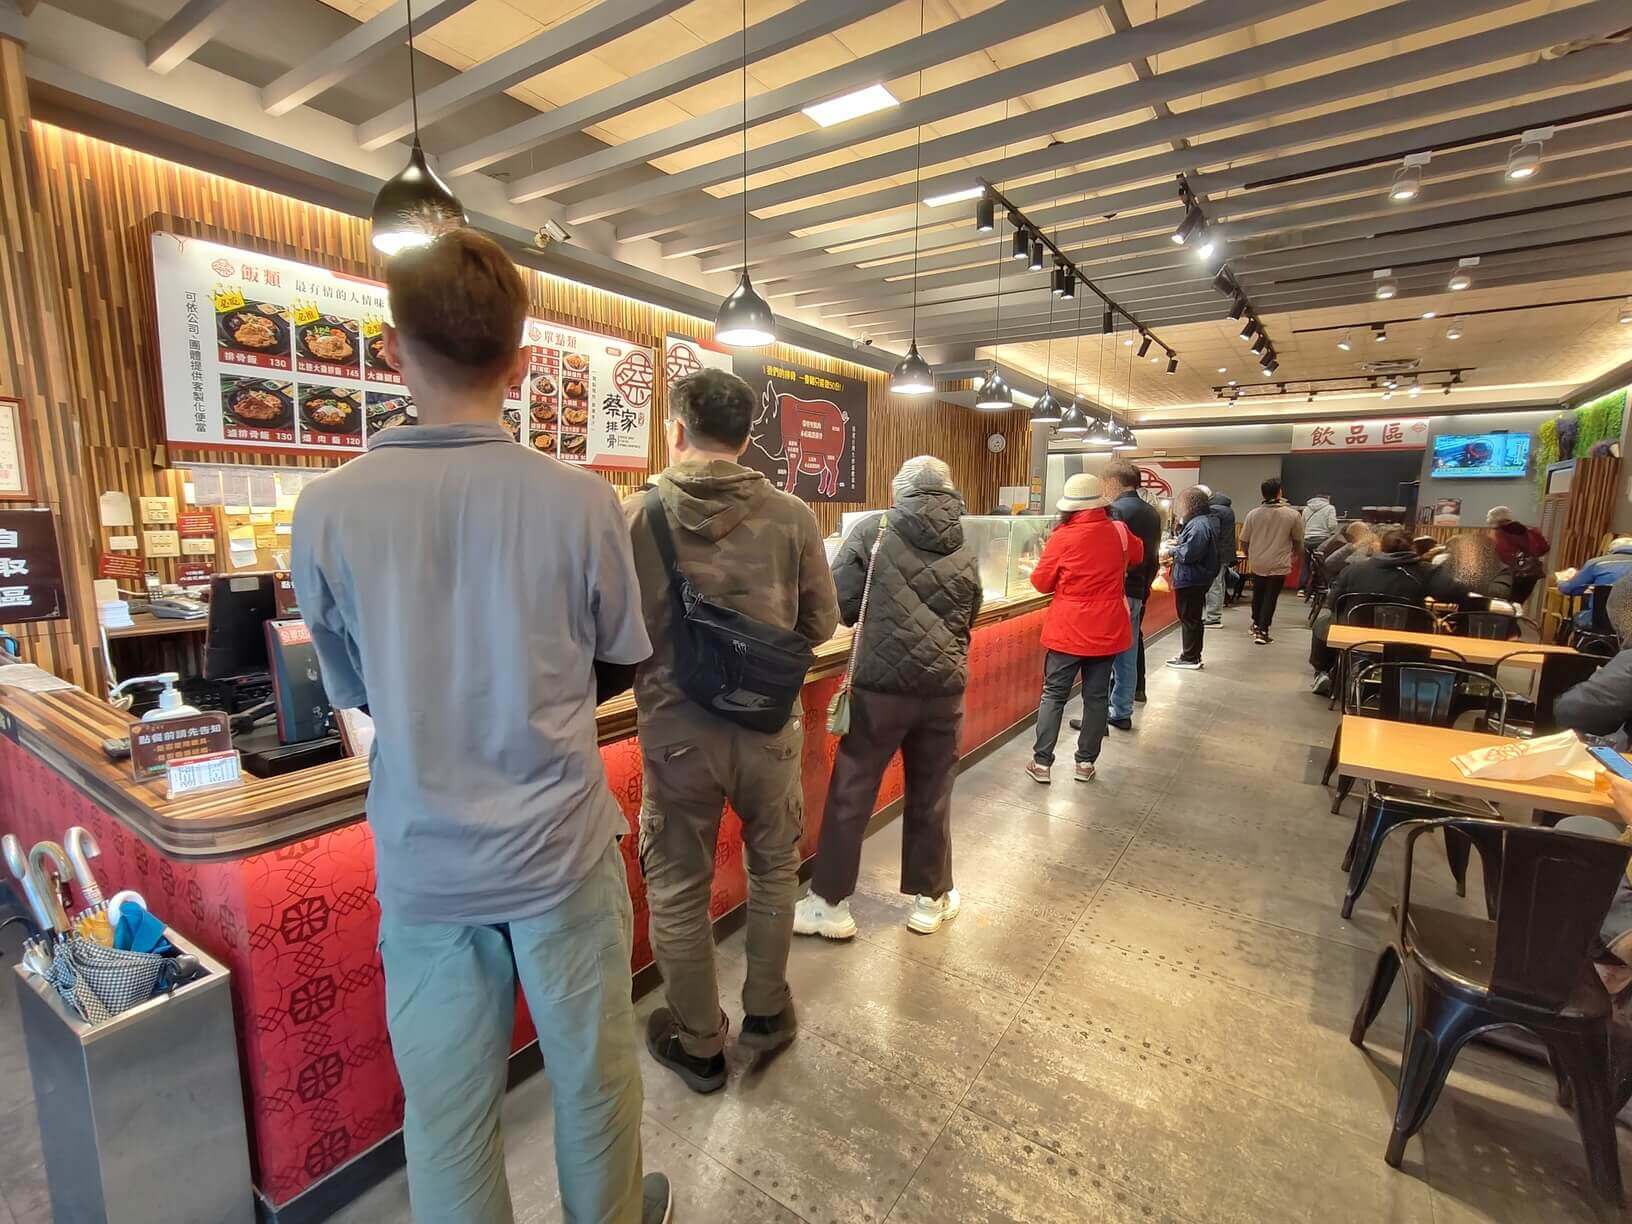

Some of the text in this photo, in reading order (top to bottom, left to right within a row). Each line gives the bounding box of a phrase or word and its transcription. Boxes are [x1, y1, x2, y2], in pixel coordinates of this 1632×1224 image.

[240, 263, 282, 288] 飯類
[295, 279, 385, 308] 最有情的人情味
[224, 351, 287, 368] 排骨飯 130
[346, 368, 360, 378] 145
[275, 432, 293, 441] 130
[345, 436, 361, 446] 120
[1311, 422, 1404, 447] 飲品區
